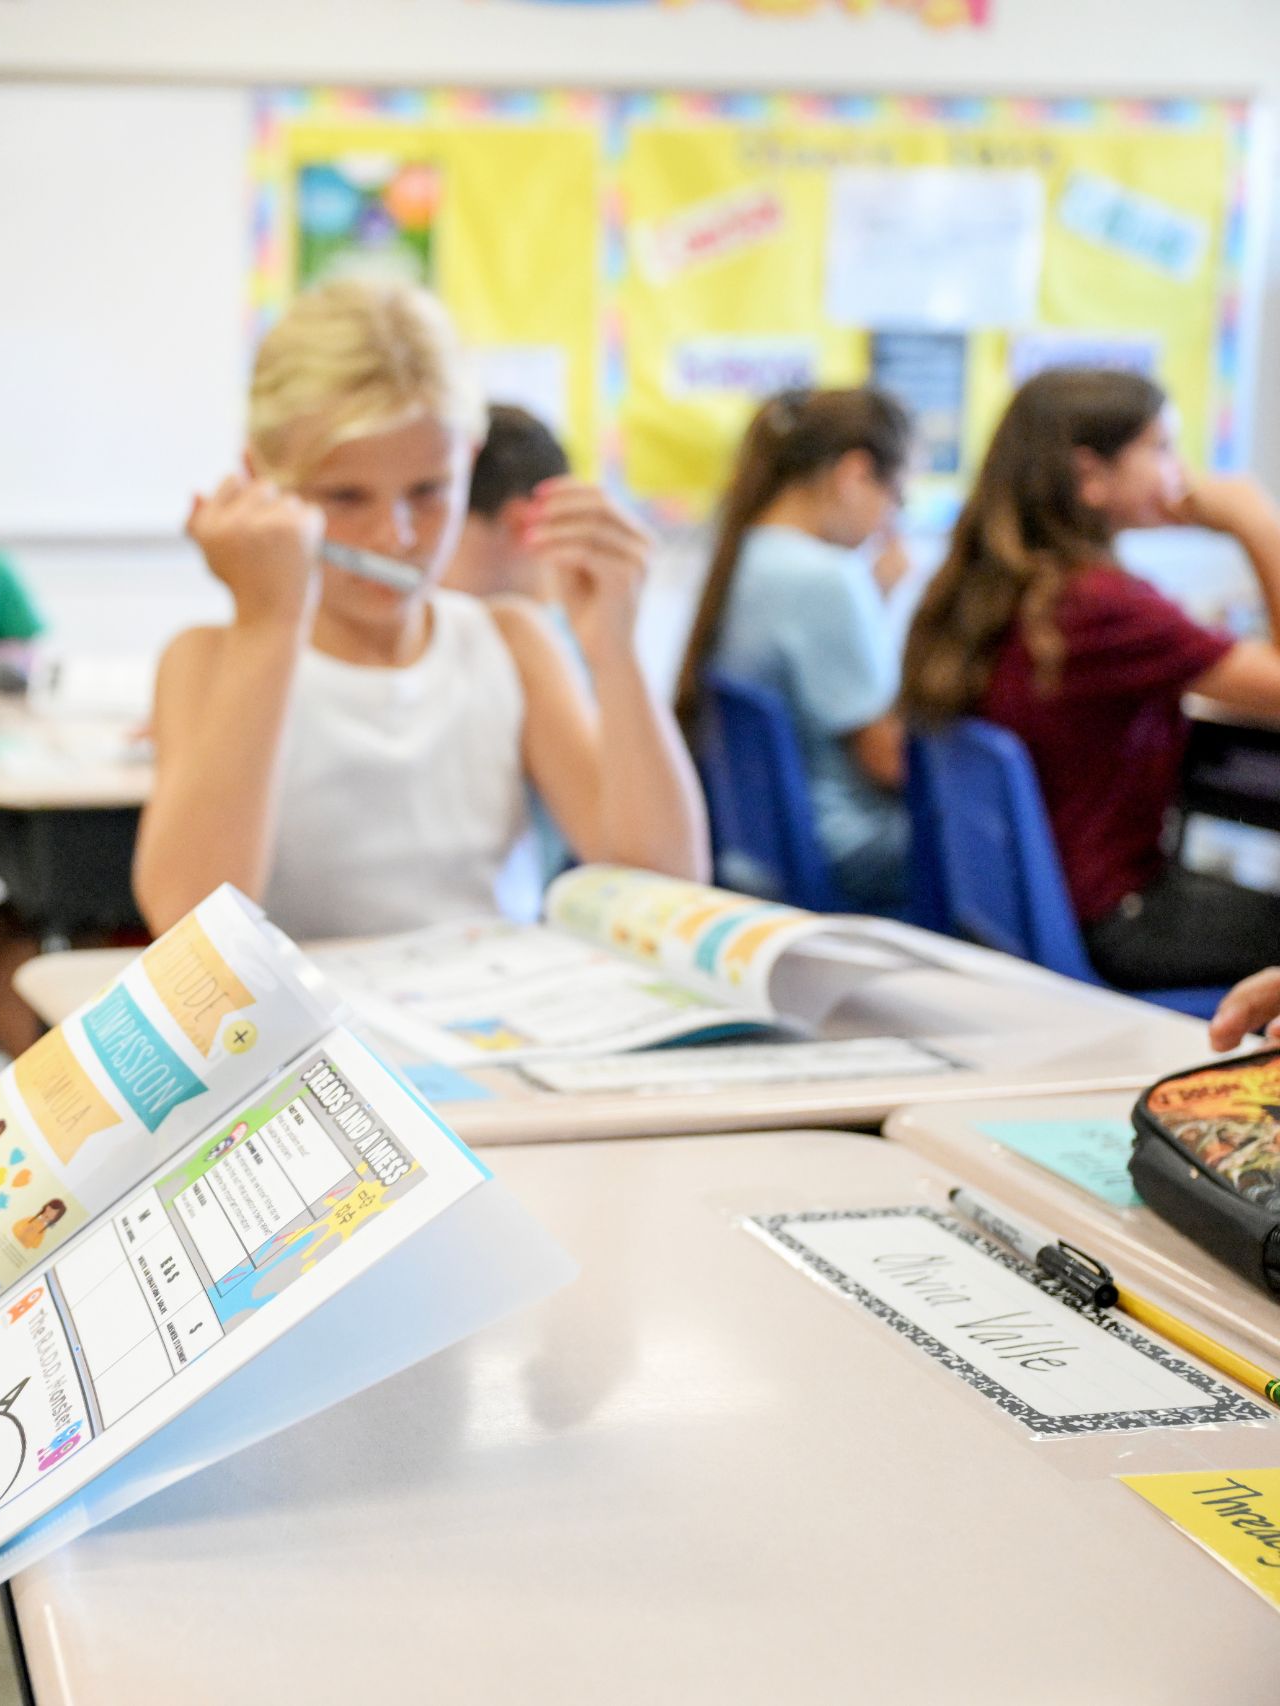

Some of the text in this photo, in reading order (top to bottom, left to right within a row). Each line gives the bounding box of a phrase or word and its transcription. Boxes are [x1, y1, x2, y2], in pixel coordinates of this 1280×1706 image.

[300, 1059, 412, 1188] 3 READS AND A MESS
[873, 1252, 1080, 1372] Olivia Valle
[47, 1375, 73, 1431] Monster
